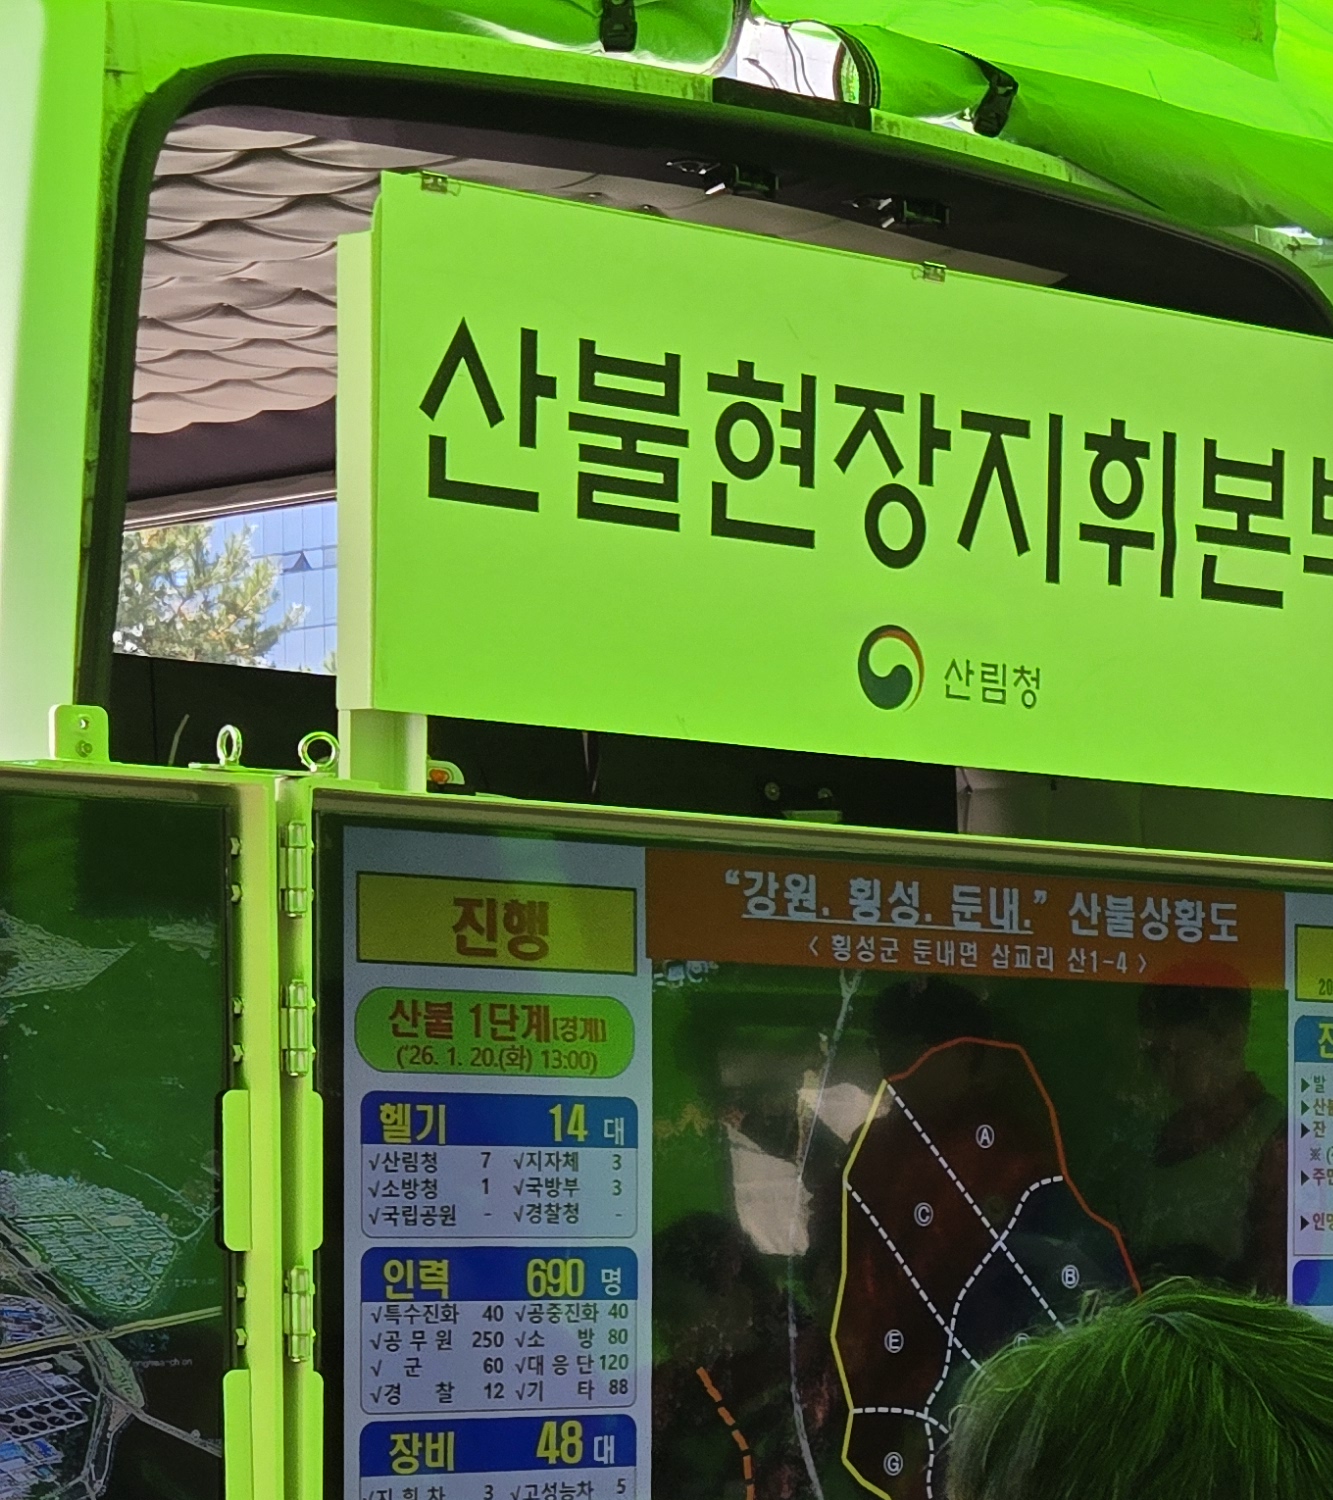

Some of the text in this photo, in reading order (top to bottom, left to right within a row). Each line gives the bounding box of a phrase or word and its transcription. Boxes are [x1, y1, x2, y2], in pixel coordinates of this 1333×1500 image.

[942, 656, 1042, 710] 산림청
[1068, 892, 1238, 943] 산불상황도
[452, 897, 550, 961] 진행
[831, 933, 1129, 975] 횡성군 둔내면 삽교리 산1-4
[389, 998, 454, 1040] 산불
[379, 1103, 625, 1145] 헬기 14 대
[382, 1152, 491, 1173] 산림청 7
[526, 1151, 622, 1172] 지자체 3
[382, 1178, 489, 1200] 소방청 1
[525, 1178, 622, 1199] 국방부 3
[382, 1204, 456, 1226] 국립공원
[525, 1204, 579, 1224] 경찰청
[383, 1258, 621, 1300] 인력 690 명
[384, 1304, 504, 1324] 특수진화 40
[527, 1303, 629, 1323] 공중진화 40
[472, 1331, 504, 1349] 250
[608, 1328, 628, 1345] 80
[404, 1357, 503, 1377] 군 60
[599, 1354, 629, 1371] 120
[484, 1383, 504, 1399] 12
[609, 1379, 629, 1395] 88
[389, 1420, 615, 1474] 장비 48 대
[485, 1485, 493, 1500] 3
[617, 1479, 625, 1494] 5
